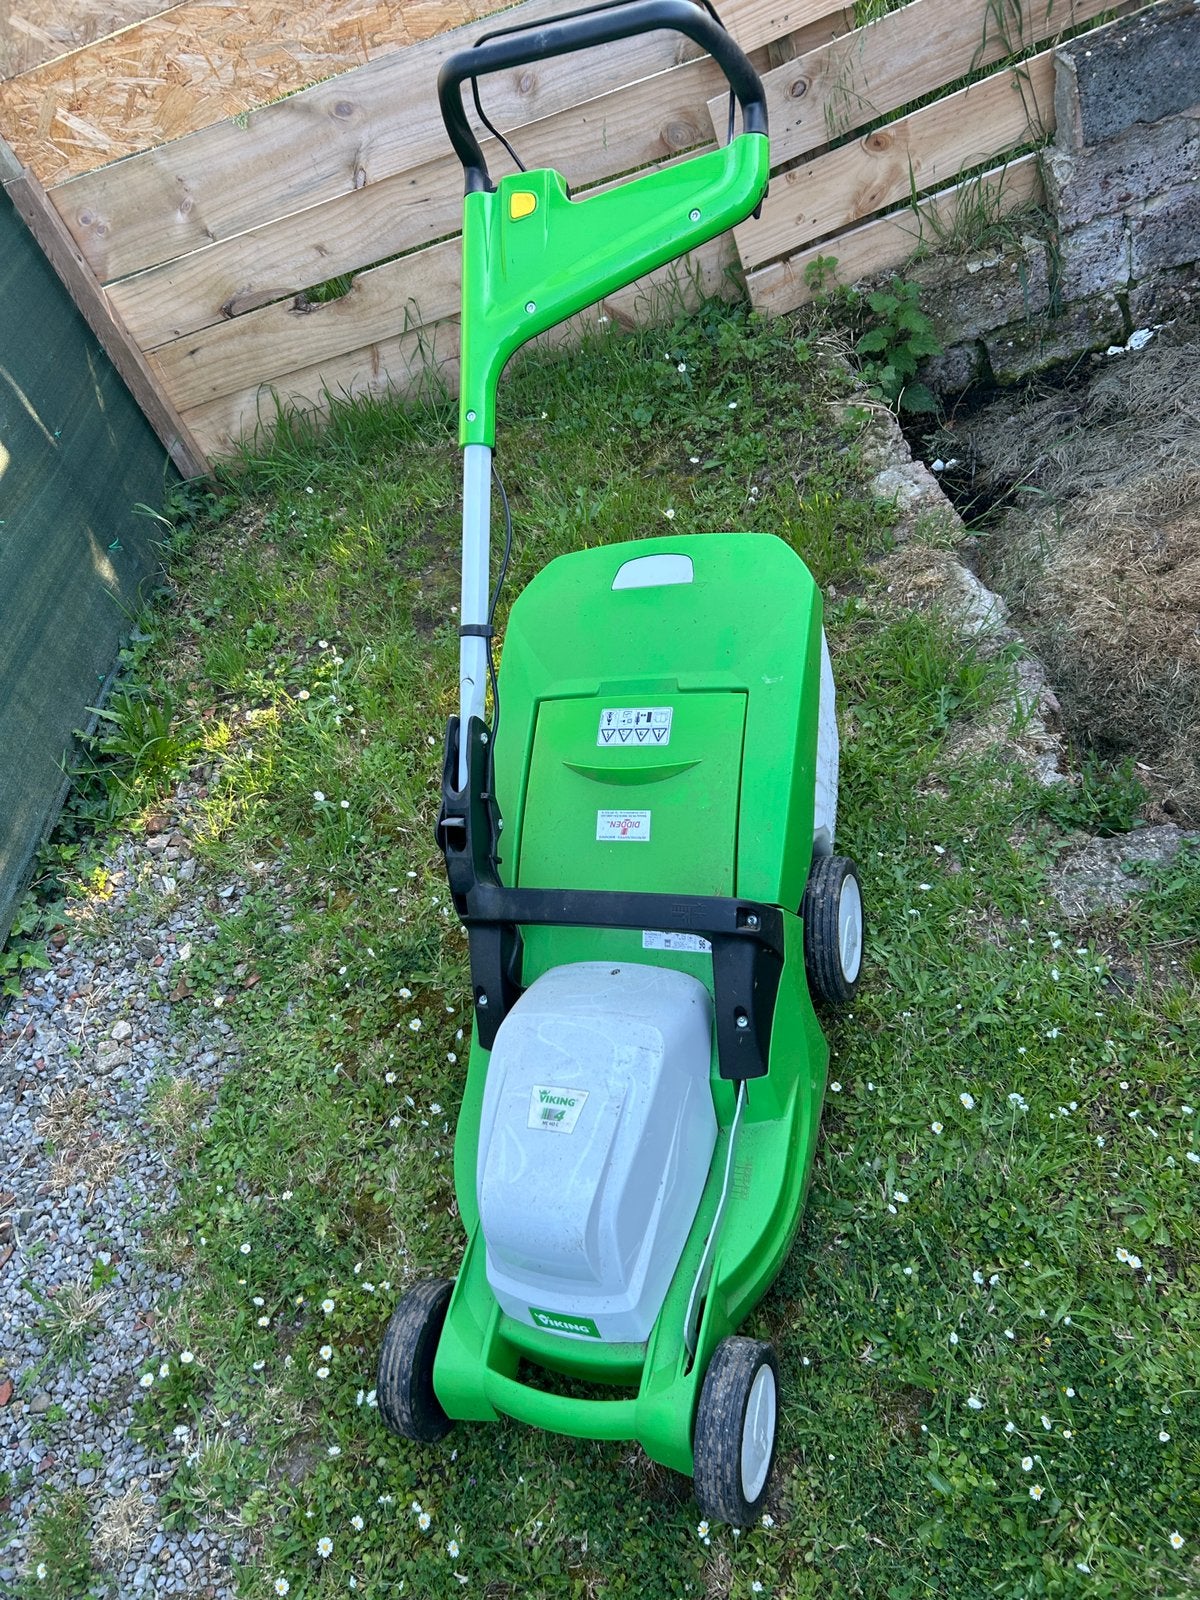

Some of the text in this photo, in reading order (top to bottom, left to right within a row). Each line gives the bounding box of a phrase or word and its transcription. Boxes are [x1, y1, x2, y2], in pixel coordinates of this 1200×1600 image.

[610, 820, 640, 828] DIDDEN
[539, 1094, 576, 1107] VIKING
[554, 1110, 566, 1121] 4
[537, 1314, 590, 1333] VIKING
